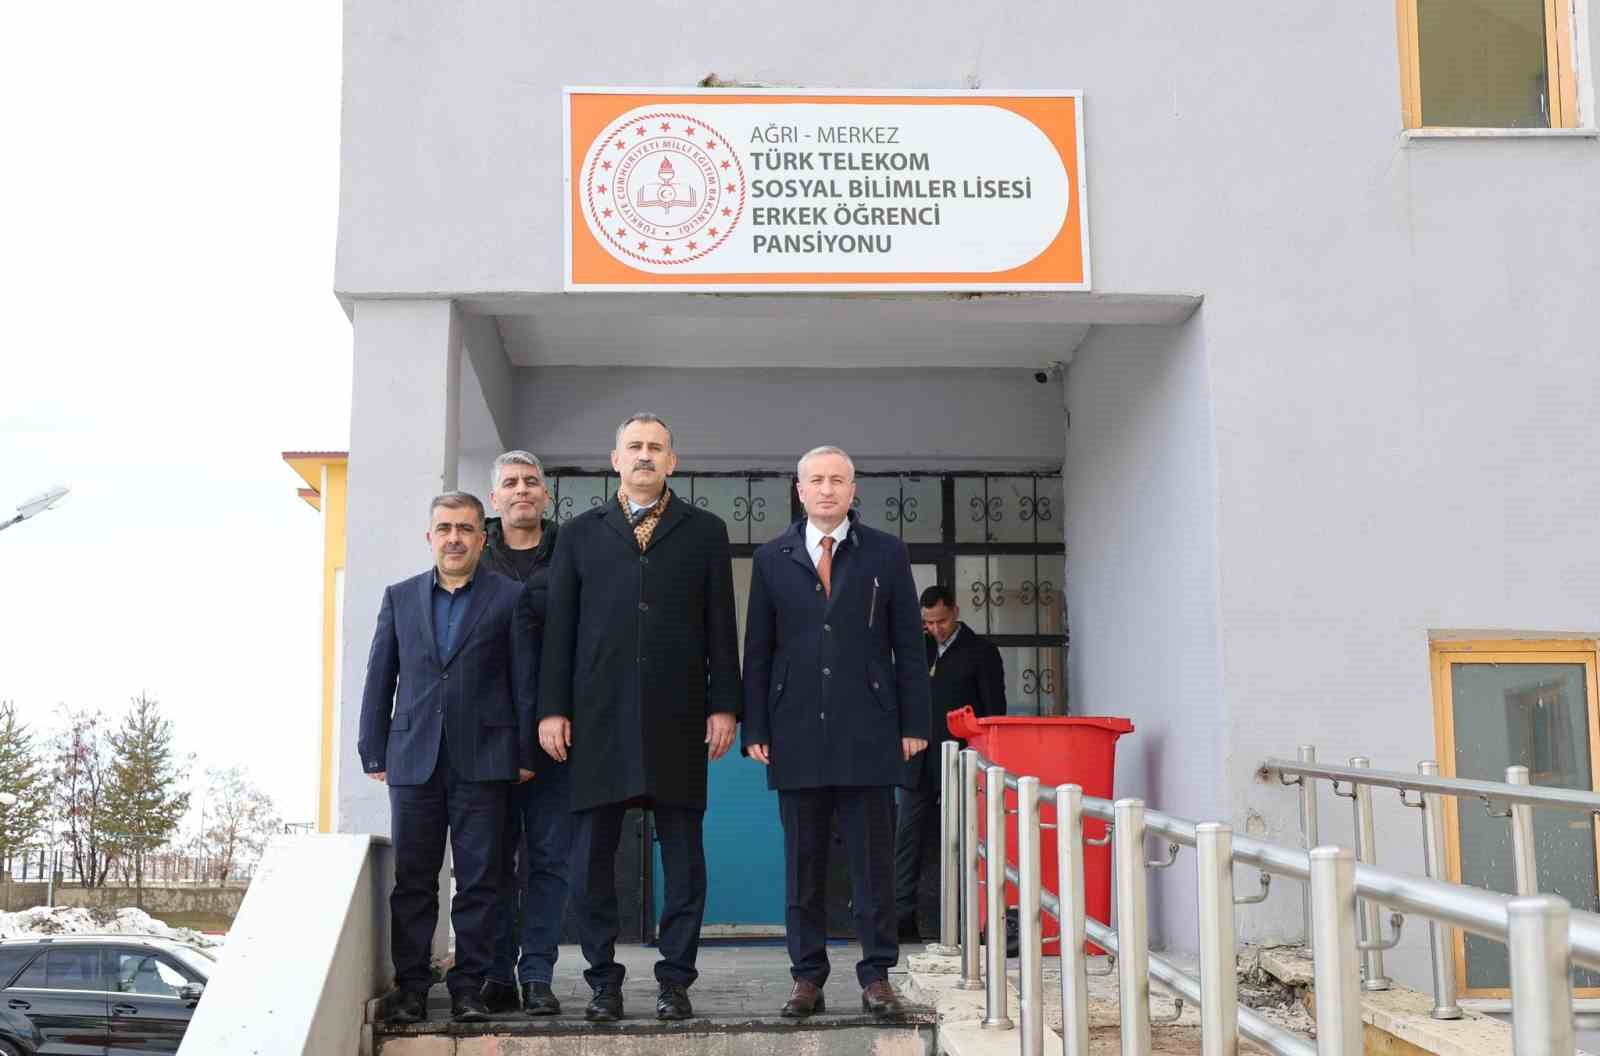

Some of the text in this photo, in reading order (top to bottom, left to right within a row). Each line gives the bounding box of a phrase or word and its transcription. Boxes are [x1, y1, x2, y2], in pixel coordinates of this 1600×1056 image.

[750, 123, 798, 144] AĞRI
[817, 126, 900, 144] MERKEZ
[750, 147, 930, 172] TÜRK TELEKOM
[751, 175, 1032, 199] SOSYAL BİLİMLER LİSESİ
[752, 202, 940, 226] ERKEK ÖĞRENCİ
[753, 229, 892, 254] PANSİYONU
